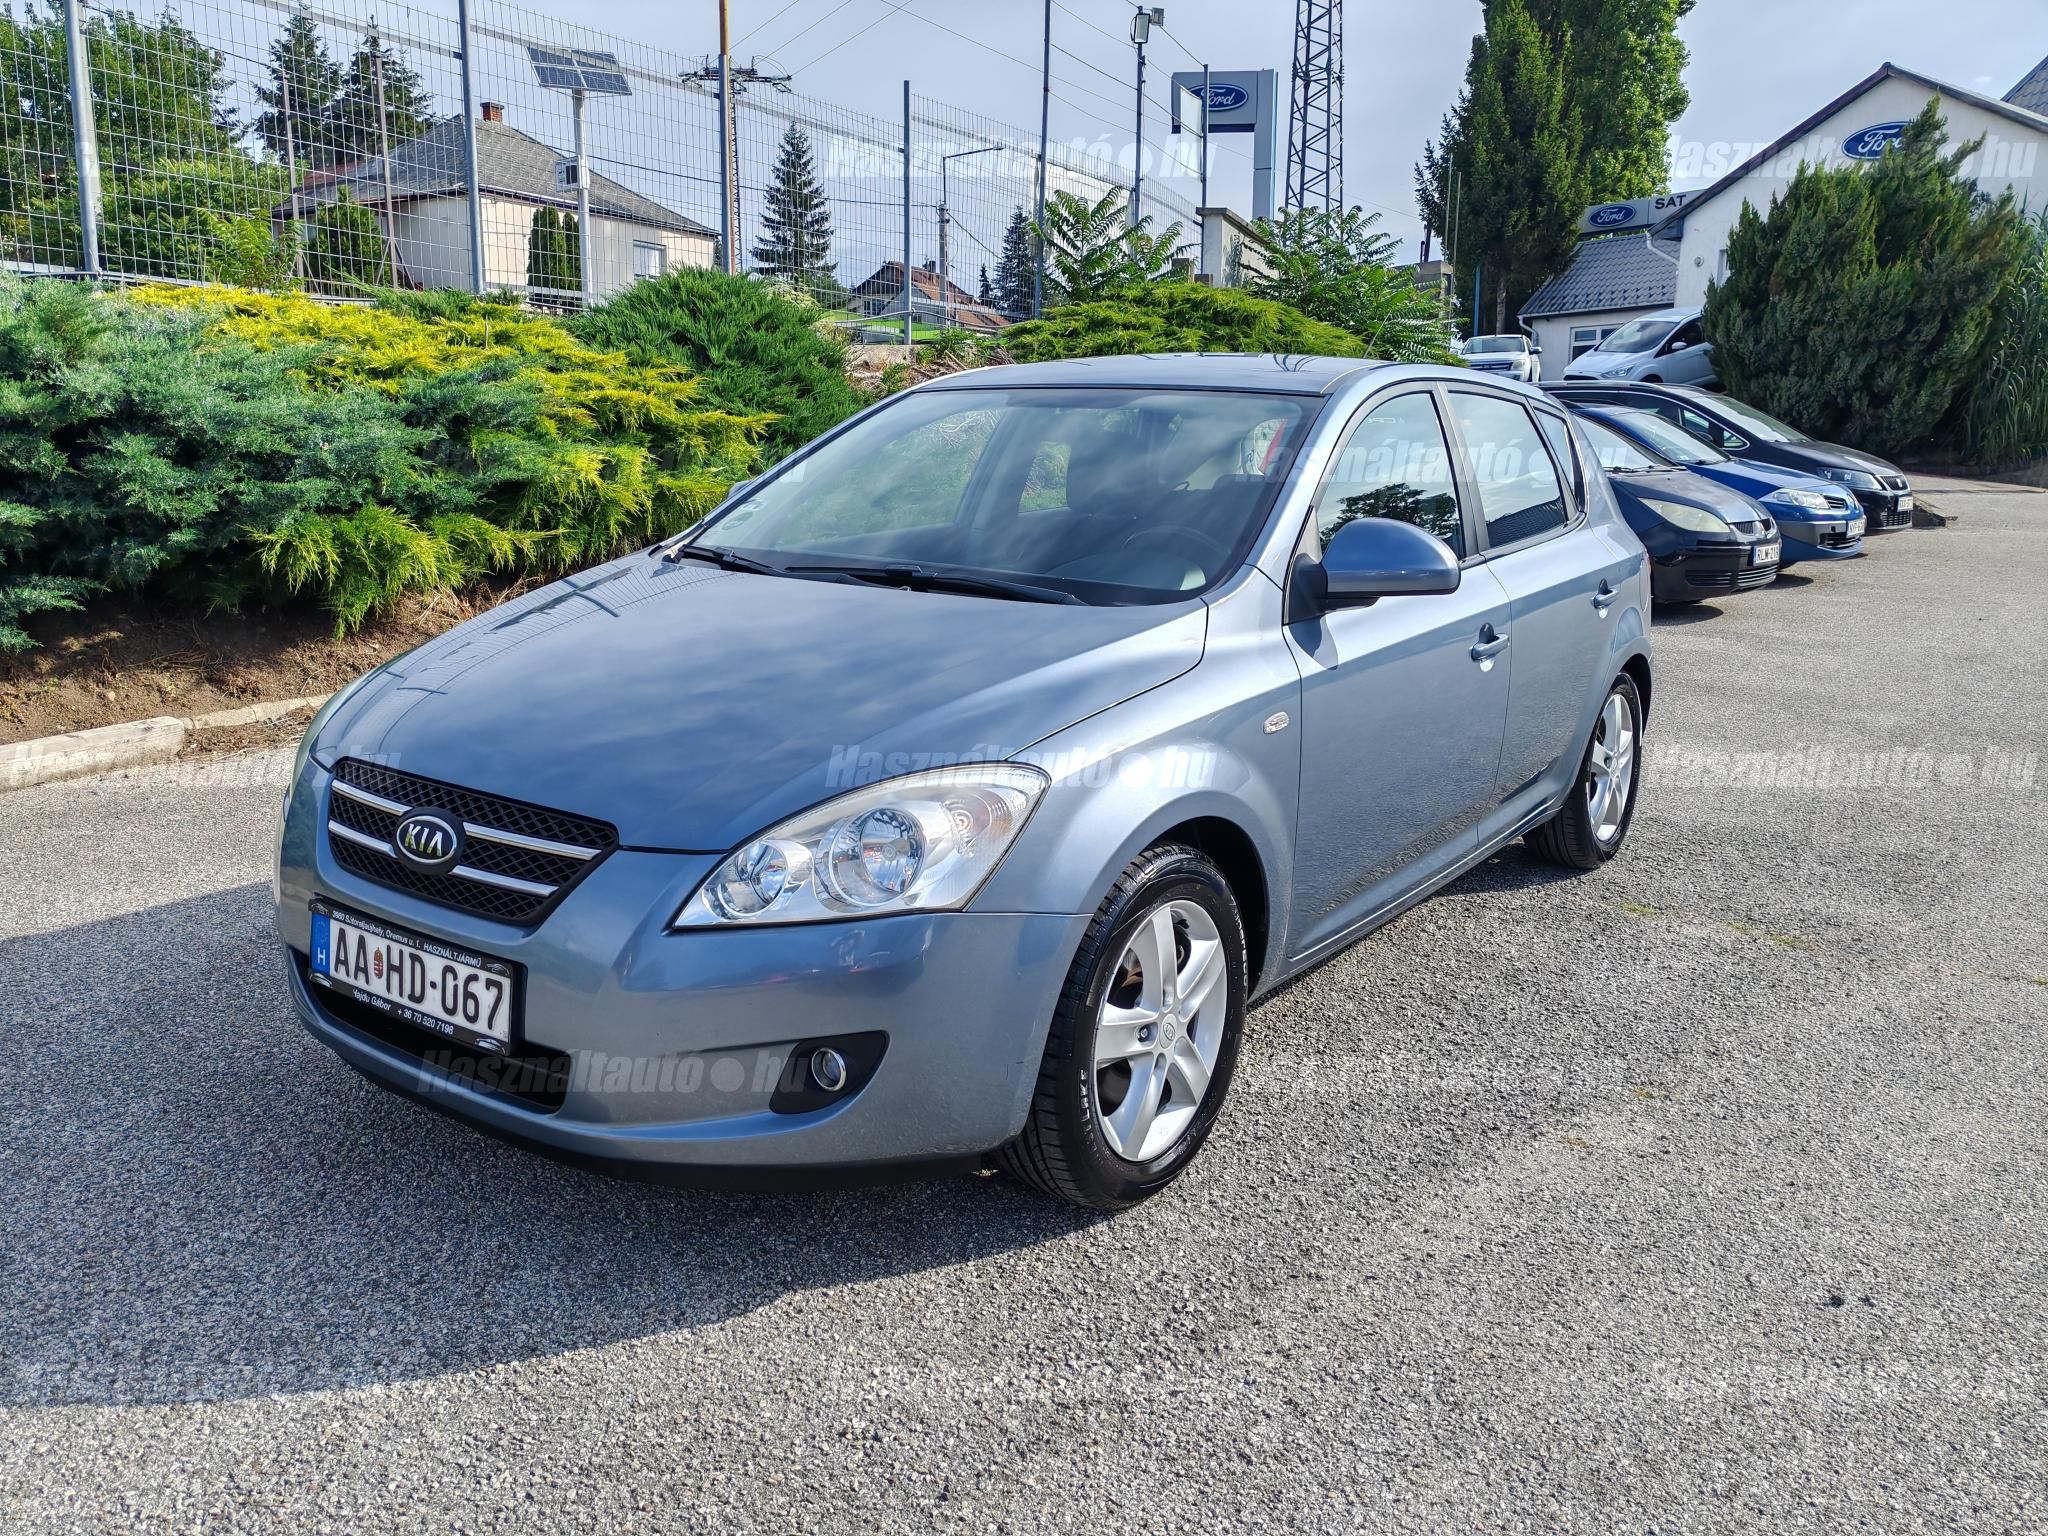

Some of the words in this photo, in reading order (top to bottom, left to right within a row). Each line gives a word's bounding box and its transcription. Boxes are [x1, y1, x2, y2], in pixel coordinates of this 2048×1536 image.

[1597, 208, 1625, 222] Ford
[1655, 194, 1687, 209] SAT
[404, 823, 443, 857] KIA
[317, 947, 326, 966] H
[422, 1016, 436, 1028] 520
[436, 1021, 454, 1035] 7198
